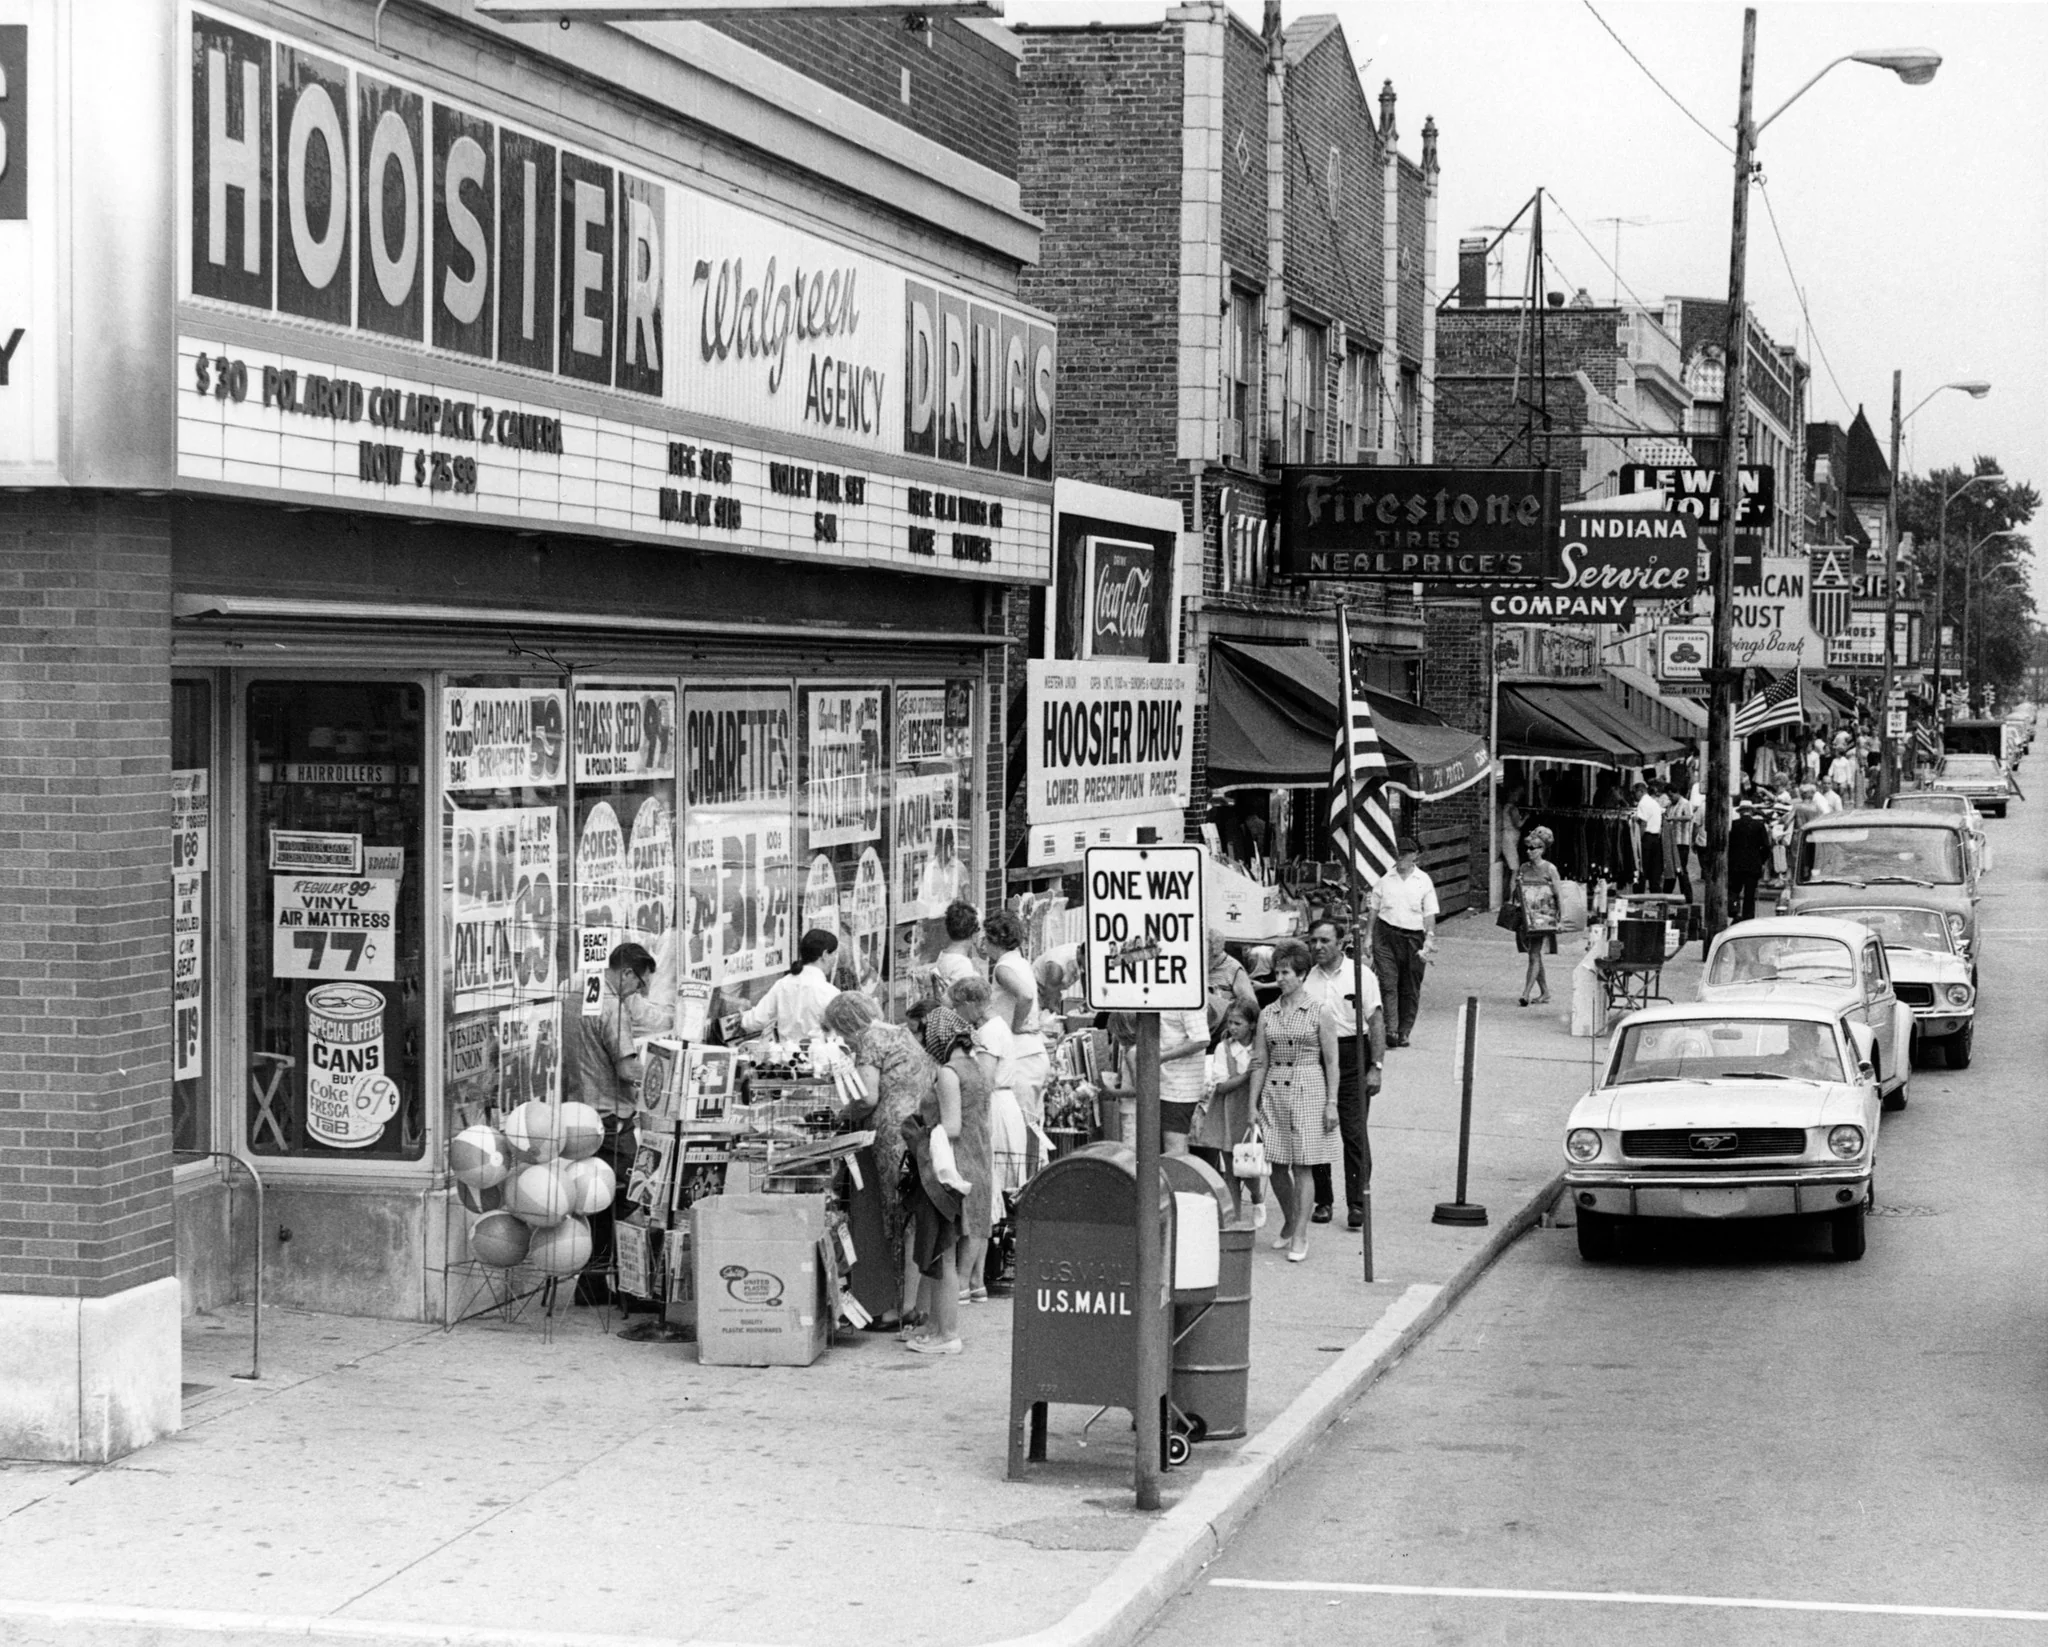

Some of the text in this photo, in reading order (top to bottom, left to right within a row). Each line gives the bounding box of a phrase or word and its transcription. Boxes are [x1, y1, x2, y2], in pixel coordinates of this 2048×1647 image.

[208, 48, 660, 372] HOOSIER
[692, 255, 860, 394] Walgreen
[805, 353, 886, 437] AGENCY
[911, 300, 1052, 463] DRUGS
[263, 365, 364, 423] POLAROID
[481, 406, 494, 445] 2
[500, 409, 564, 454] CAMERA
[359, 440, 403, 486] NOW
[770, 461, 813, 498] VOLLEY
[846, 475, 866, 505] SET
[1634, 470, 1761, 494] LEWN
[1297, 474, 1540, 527] Firestone
[1375, 530, 1461, 549] TIRES
[1581, 519, 1688, 539] INDIANA
[1310, 553, 1523, 574] NEAL PRICE'S
[1552, 543, 1690, 588] Service
[1490, 596, 1629, 616] COMPANY
[1732, 604, 1785, 629] RUST
[1767, 629, 1805, 657] Bank
[1831, 640, 1853, 650] THE
[1845, 627, 1876, 638] HOES
[1830, 653, 1899, 663] FISHERMN
[473, 699, 531, 745] CHARCOAL
[577, 700, 642, 755] GRASS SEED
[1043, 700, 1132, 768] HOOSIER
[1136, 699, 1184, 763] DRUG
[446, 730, 474, 758] POUND
[687, 709, 790, 806] CIGARETTES
[450, 760, 467, 783] BAG
[592, 757, 612, 775] POUND
[1046, 770, 1178, 806] LOWER PRESCRIPTION PRICES
[897, 794, 932, 849] AQUA
[278, 852, 352, 865] SIDEWALK SALE
[327, 844, 352, 854] DAYS
[582, 829, 618, 862] COKES
[634, 842, 667, 871] PANTY
[368, 852, 401, 871] special
[293, 880, 348, 895] REGULAR
[634, 871, 665, 903] HOSE
[902, 849, 928, 904] NET
[1093, 870, 1194, 900] ONE WAY
[301, 896, 358, 910] VINYL
[176, 917, 200, 932] COOLED
[279, 910, 390, 928] AIR MATTRESS
[1095, 913, 1194, 942] DO NOT
[179, 939, 195, 955] CAR
[583, 933, 608, 948] BEACH
[176, 957, 197, 978] SEAT
[584, 948, 607, 962] BALLS
[1104, 955, 1187, 984] ENTER
[586, 976, 600, 1003] 29
[309, 1013, 383, 1042] SPECIAL OFFER
[313, 1043, 379, 1073] CANS
[455, 1048, 483, 1073] UNION
[310, 1079, 349, 1102] Coke
[332, 1074, 356, 1085] BUY
[310, 1095, 350, 1119] FRESCA
